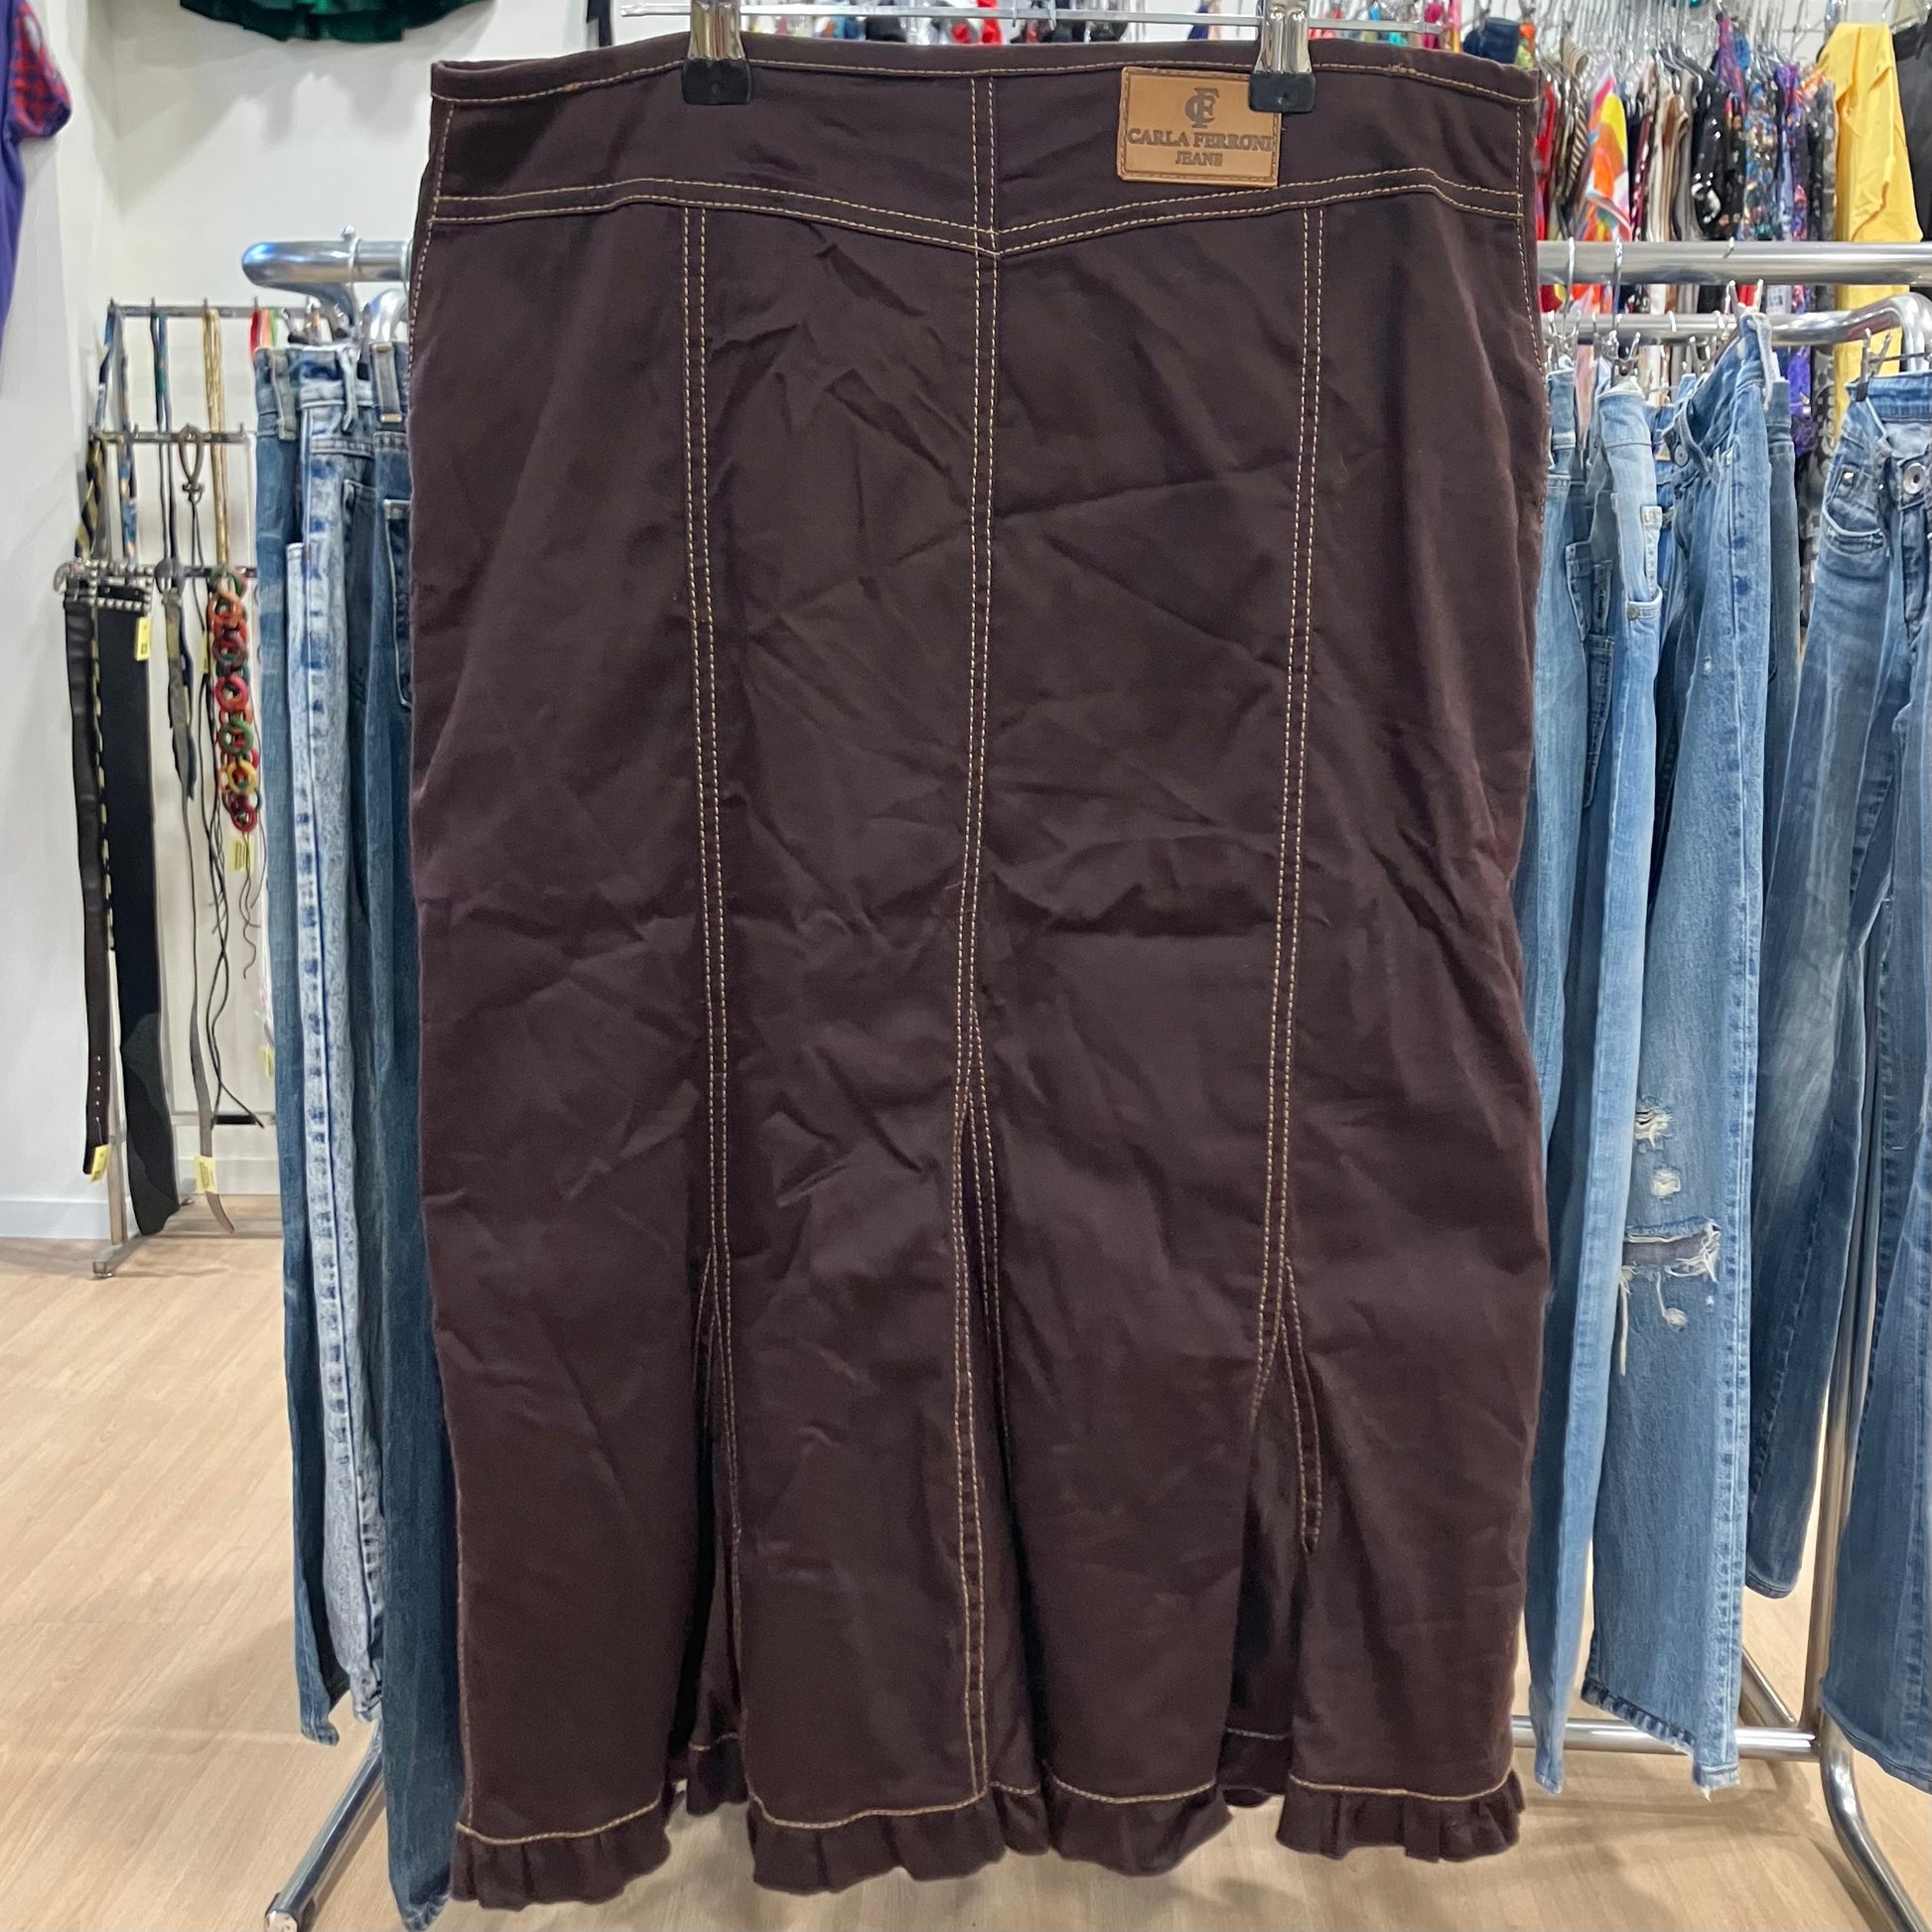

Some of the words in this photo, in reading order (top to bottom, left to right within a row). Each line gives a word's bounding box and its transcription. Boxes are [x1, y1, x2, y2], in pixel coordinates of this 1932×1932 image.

[1128, 128, 1189, 147] CARLA
[1193, 132, 1273, 152] FERRONI
[1175, 151, 1223, 167] JEANS
